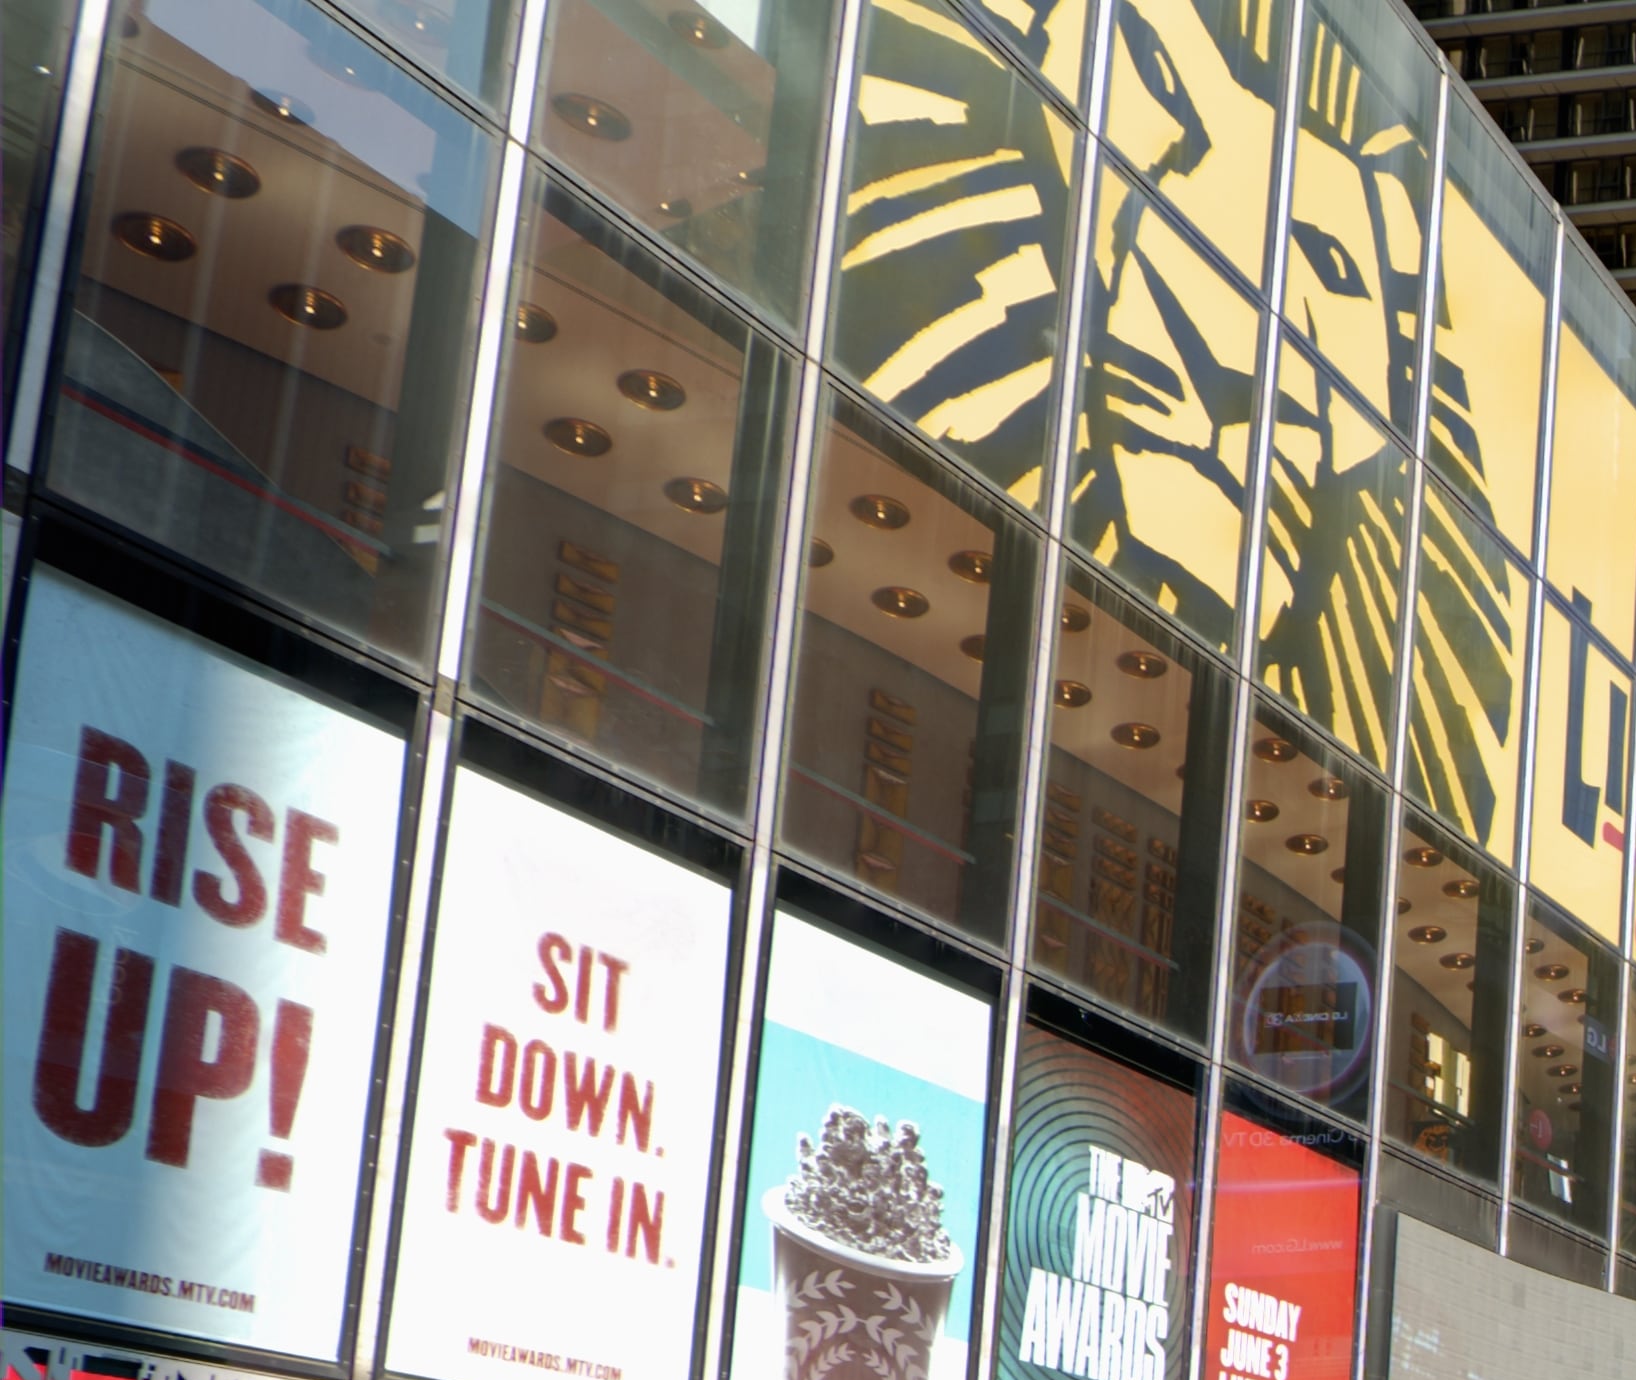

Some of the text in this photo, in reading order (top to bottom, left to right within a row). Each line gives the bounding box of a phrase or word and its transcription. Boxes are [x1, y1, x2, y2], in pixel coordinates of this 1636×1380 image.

[64, 724, 340, 957] RISE
[531, 930, 632, 1034] SIT
[31, 926, 315, 1193] UP!
[475, 1021, 665, 1158] DOWN.
[443, 1127, 677, 1269] TUNE IN.
[1089, 1145, 1122, 1202] THE
[44, 1251, 256, 1314] MOVIEAWARDS.MTV.COM
[1072, 1192, 1173, 1307] MOVIE
[1220, 1328, 1271, 1378] JUNE
[1222, 1282, 1303, 1343] SUNDAY
